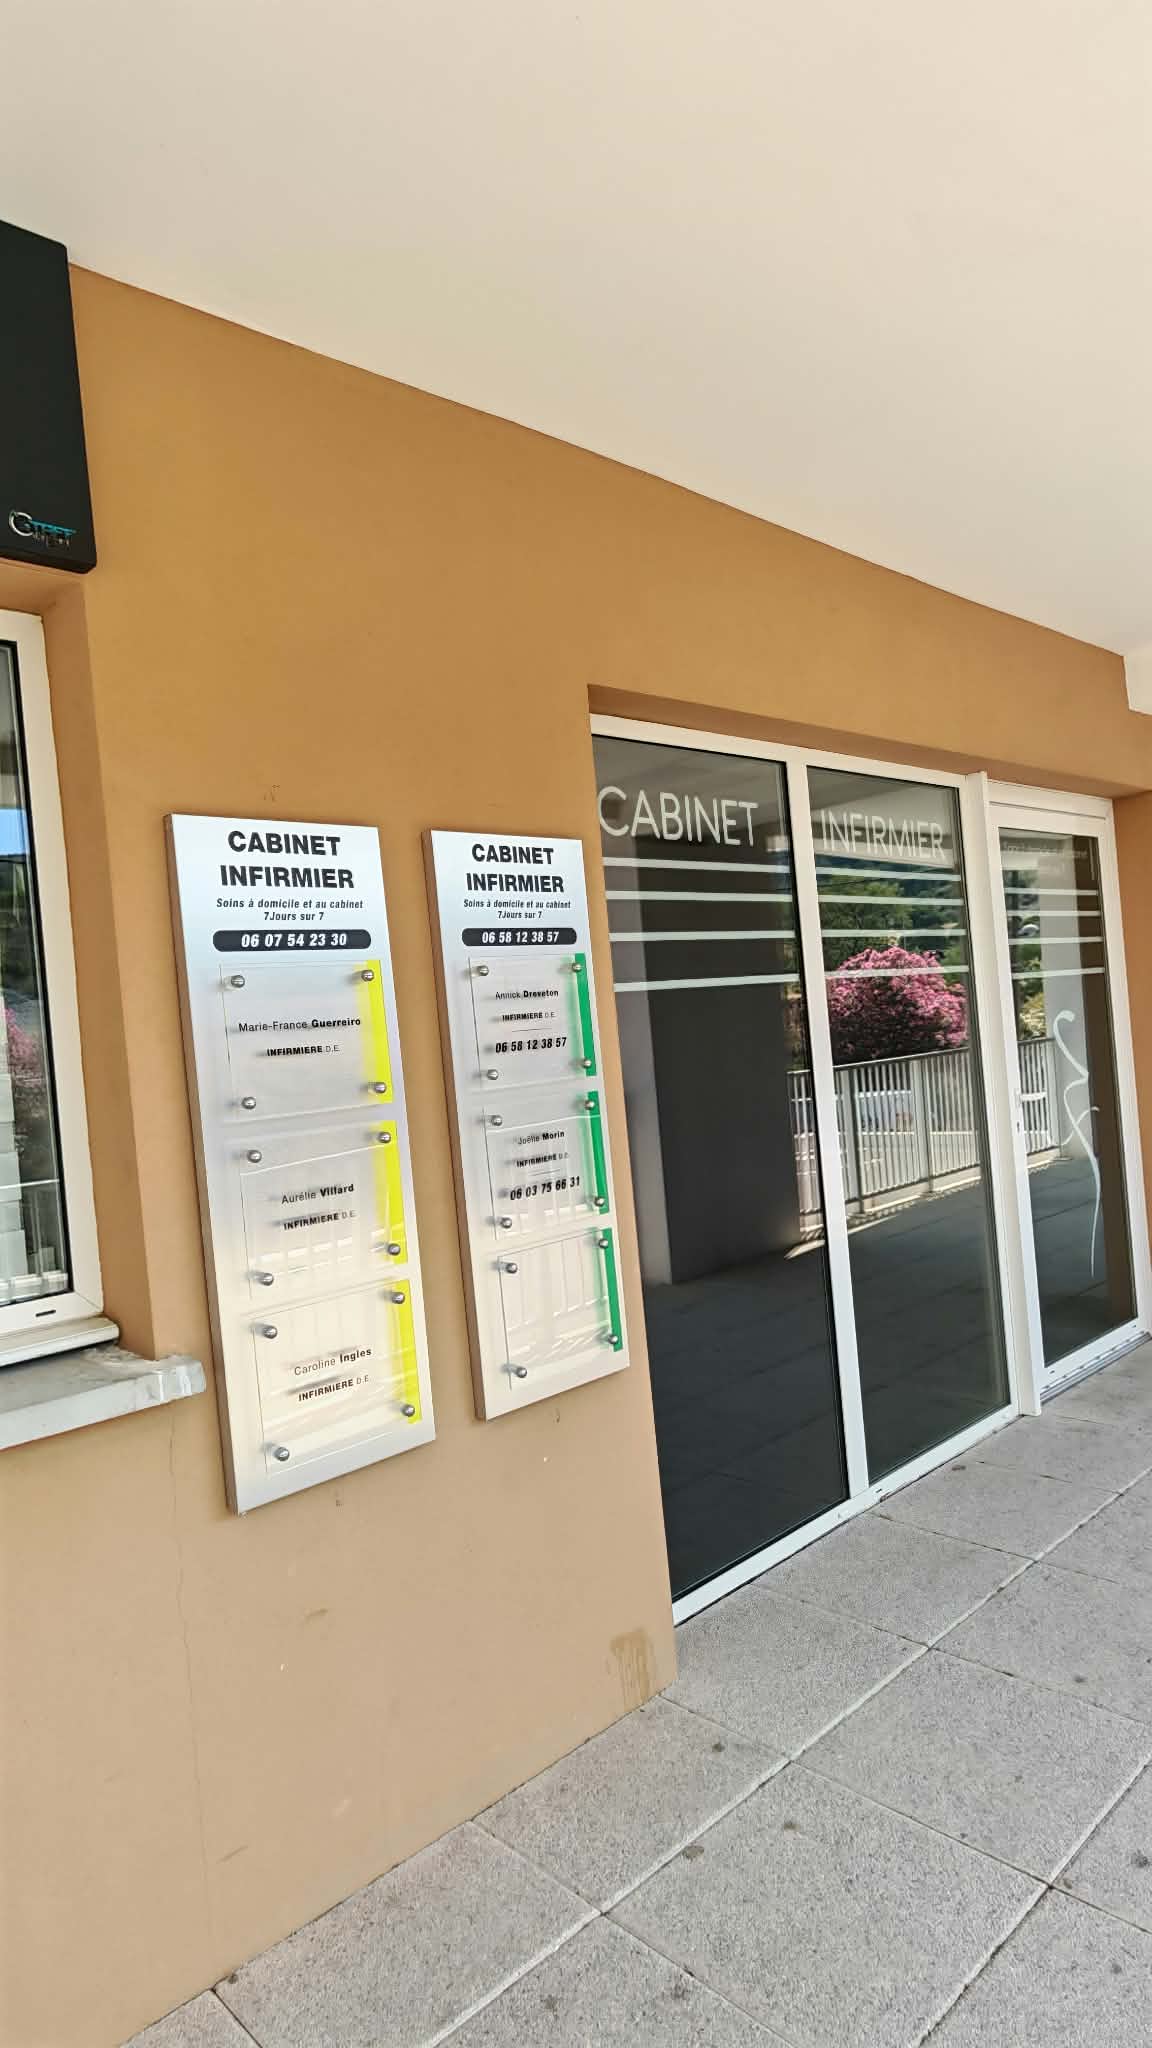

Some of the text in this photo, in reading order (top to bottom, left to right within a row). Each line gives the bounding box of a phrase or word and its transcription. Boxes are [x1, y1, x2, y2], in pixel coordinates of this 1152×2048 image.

[598, 786, 947, 861] CABINET INFIRMIER
[227, 830, 341, 856] CABINET
[471, 844, 554, 865] CABINET
[220, 865, 355, 889] INFIRMIER
[466, 873, 565, 893] INFIRMIER
[216, 898, 364, 909] Soins à domicile et au cabinet
[463, 898, 571, 909] Soins à domicile et au cabinet
[300, 912, 316, 921] sur
[318, 911, 325, 921] 7
[524, 911, 536, 919] sur
[538, 910, 543, 919] 7
[241, 932, 348, 948] 06 07 54 23 30
[482, 931, 560, 944] 06 58 12 38 57
[495, 991, 521, 1001] Annick
[502, 1012, 543, 1022] INFIRMIERE
[238, 1018, 361, 1033] Marie-France Guerreiro
[266, 1045, 323, 1057] INFIRMIERE
[495, 1037, 567, 1053] 06 58 12 38 57
[542, 1130, 565, 1141] Morin
[281, 1184, 354, 1204] Aurélie Villard
[510, 1188, 523, 1201] 06
[525, 1184, 538, 1198] 03
[541, 1181, 552, 1194] 75
[569, 1175, 580, 1188] 31
[283, 1212, 340, 1231] INFIRMIERE
[294, 1348, 372, 1376] Caroline Ingles
[298, 1378, 354, 1402] INFIRMIERE
